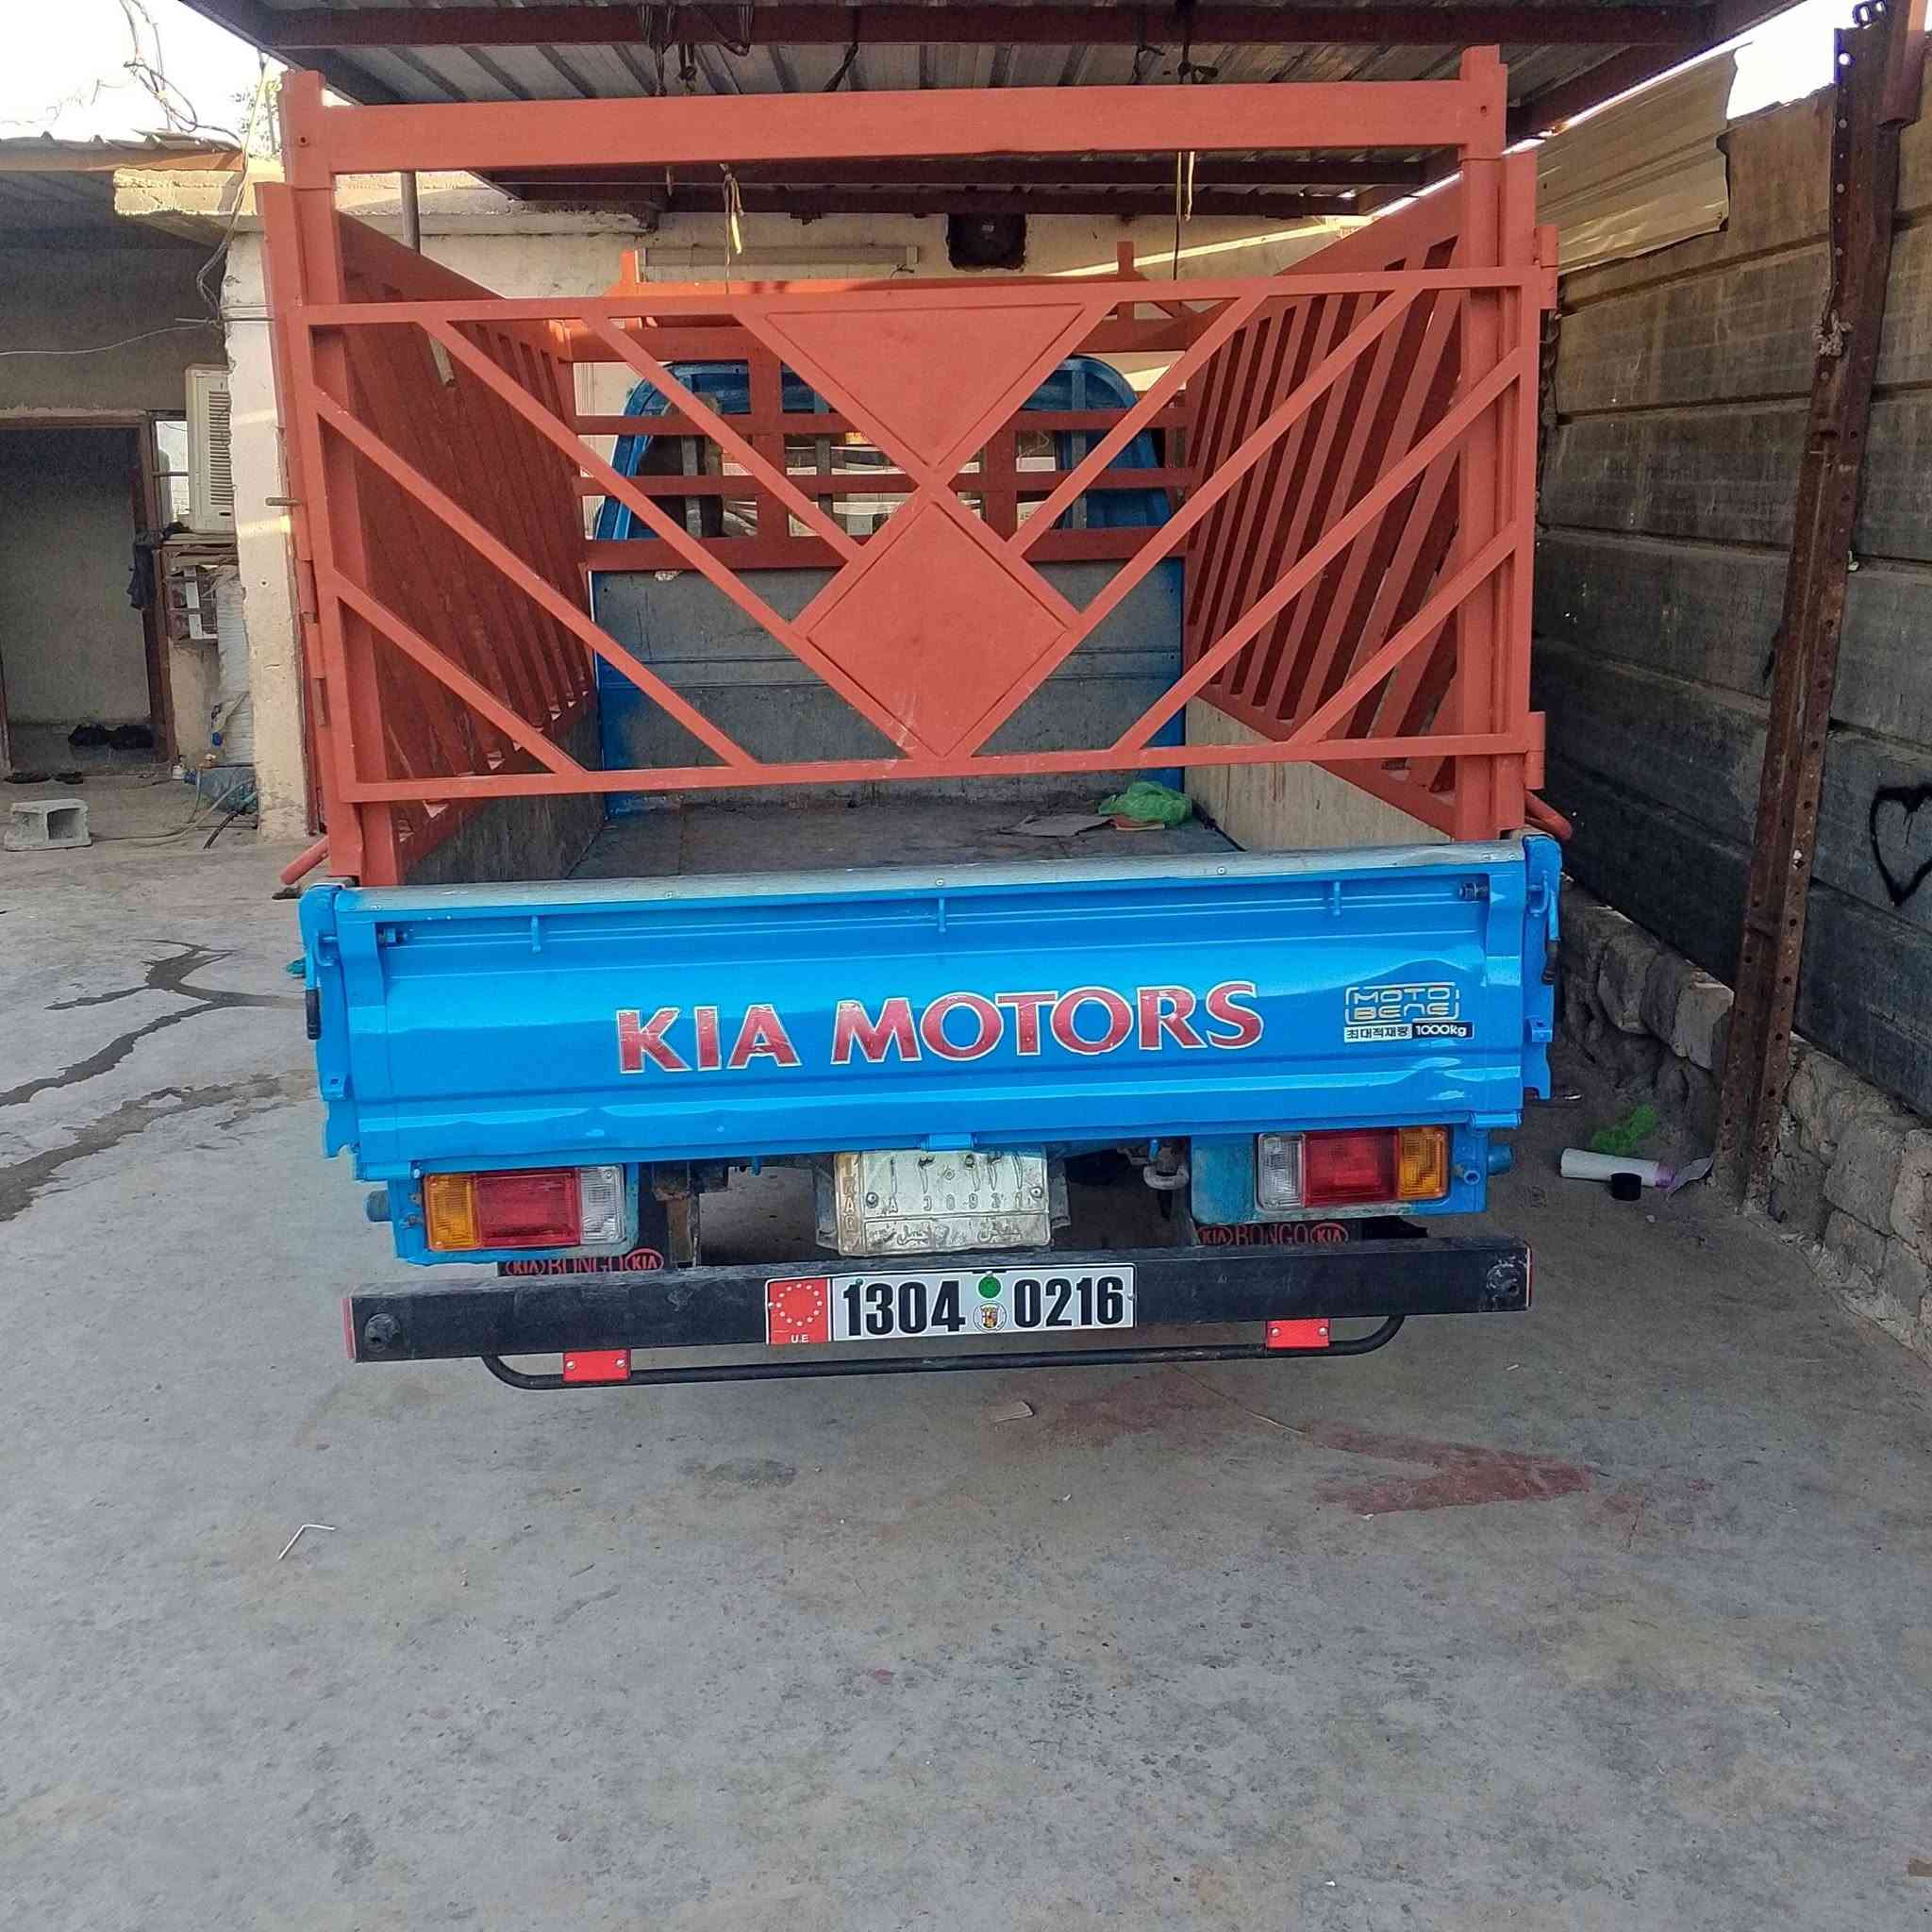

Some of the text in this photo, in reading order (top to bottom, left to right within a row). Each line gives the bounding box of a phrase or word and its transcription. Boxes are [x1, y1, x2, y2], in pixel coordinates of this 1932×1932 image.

[1353, 987, 1451, 1005] MOTO
[615, 981, 1265, 1074] KIA MOTORS
[631, 1254, 658, 1271] KIA
[842, 1275, 1124, 1337] 1304 0216
